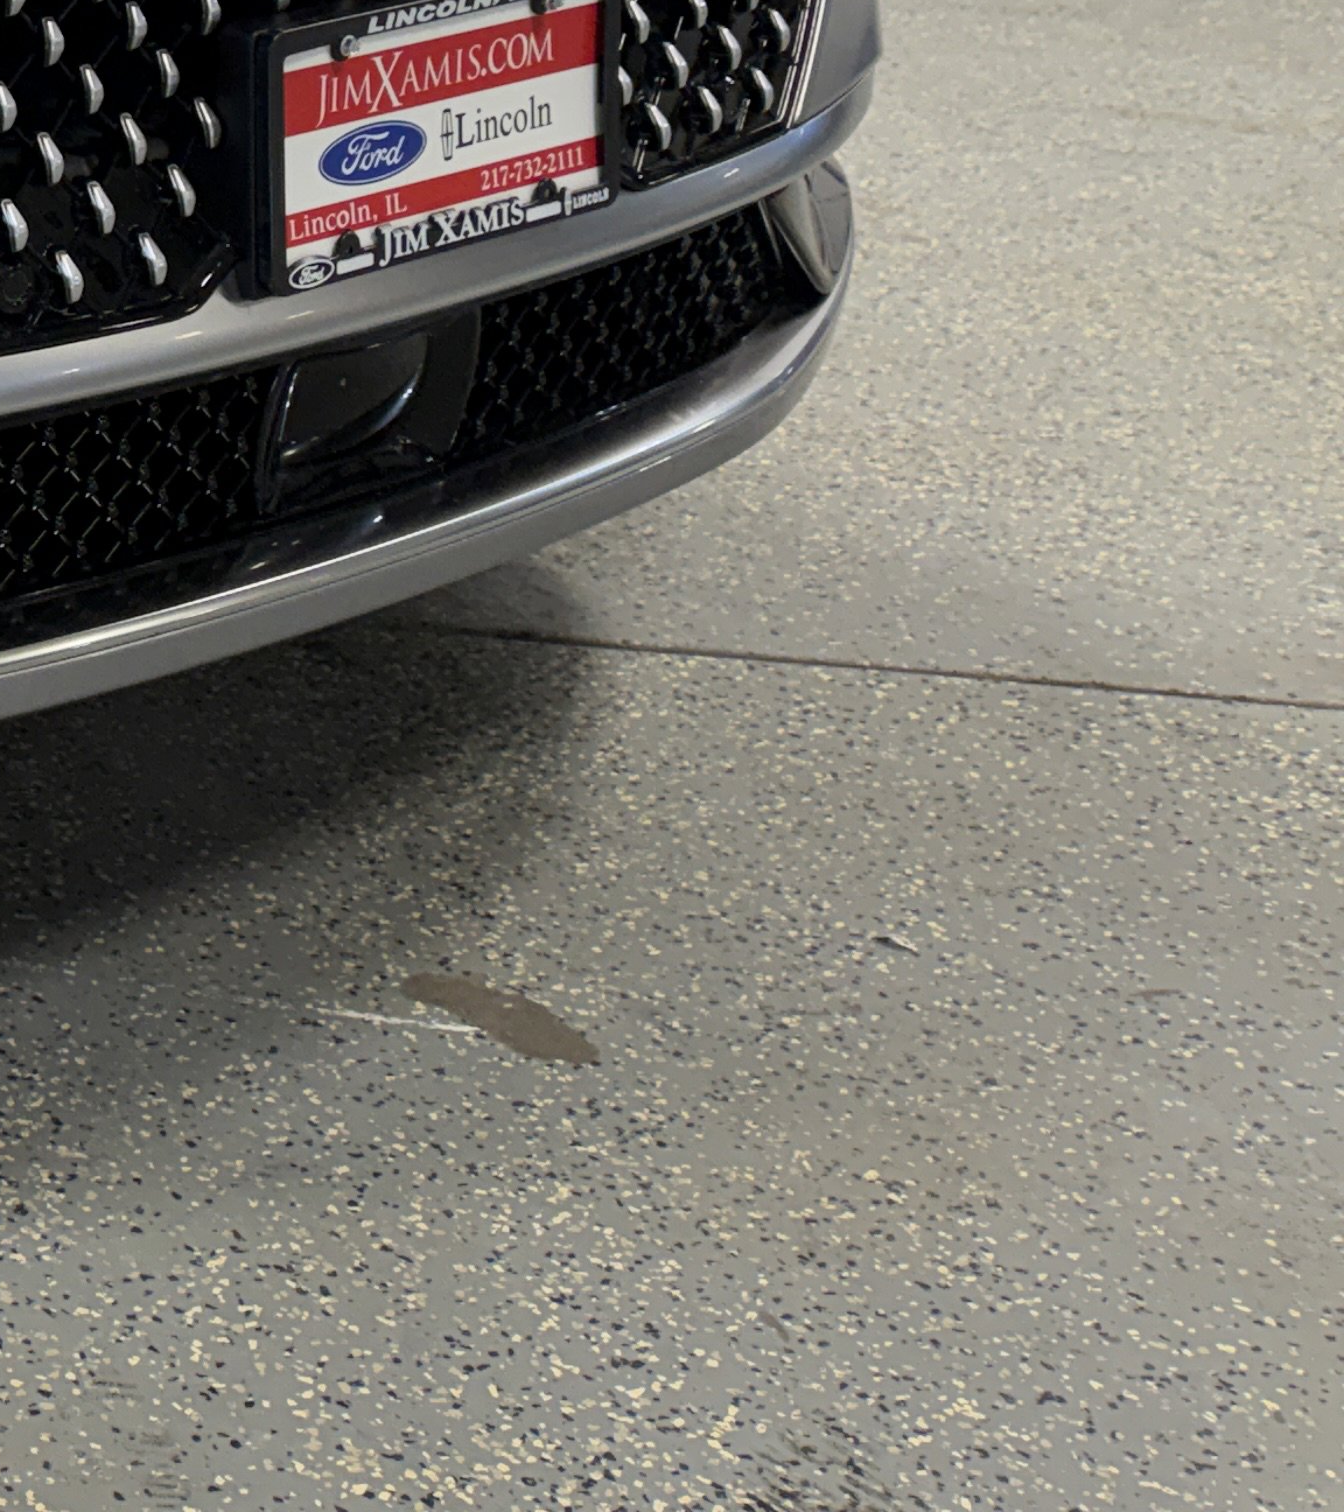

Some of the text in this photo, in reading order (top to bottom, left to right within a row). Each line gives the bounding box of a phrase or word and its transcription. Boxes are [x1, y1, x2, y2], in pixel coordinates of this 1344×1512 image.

[316, 28, 554, 128] JIMXAMIS.COM
[455, 95, 553, 150] Lincoln
[341, 131, 405, 175] Ford
[481, 146, 584, 191] 217-732-2111
[289, 194, 407, 241] Lincoln, IL
[571, 187, 610, 210] LINCOLN
[378, 201, 527, 267] JIM XAMIS
